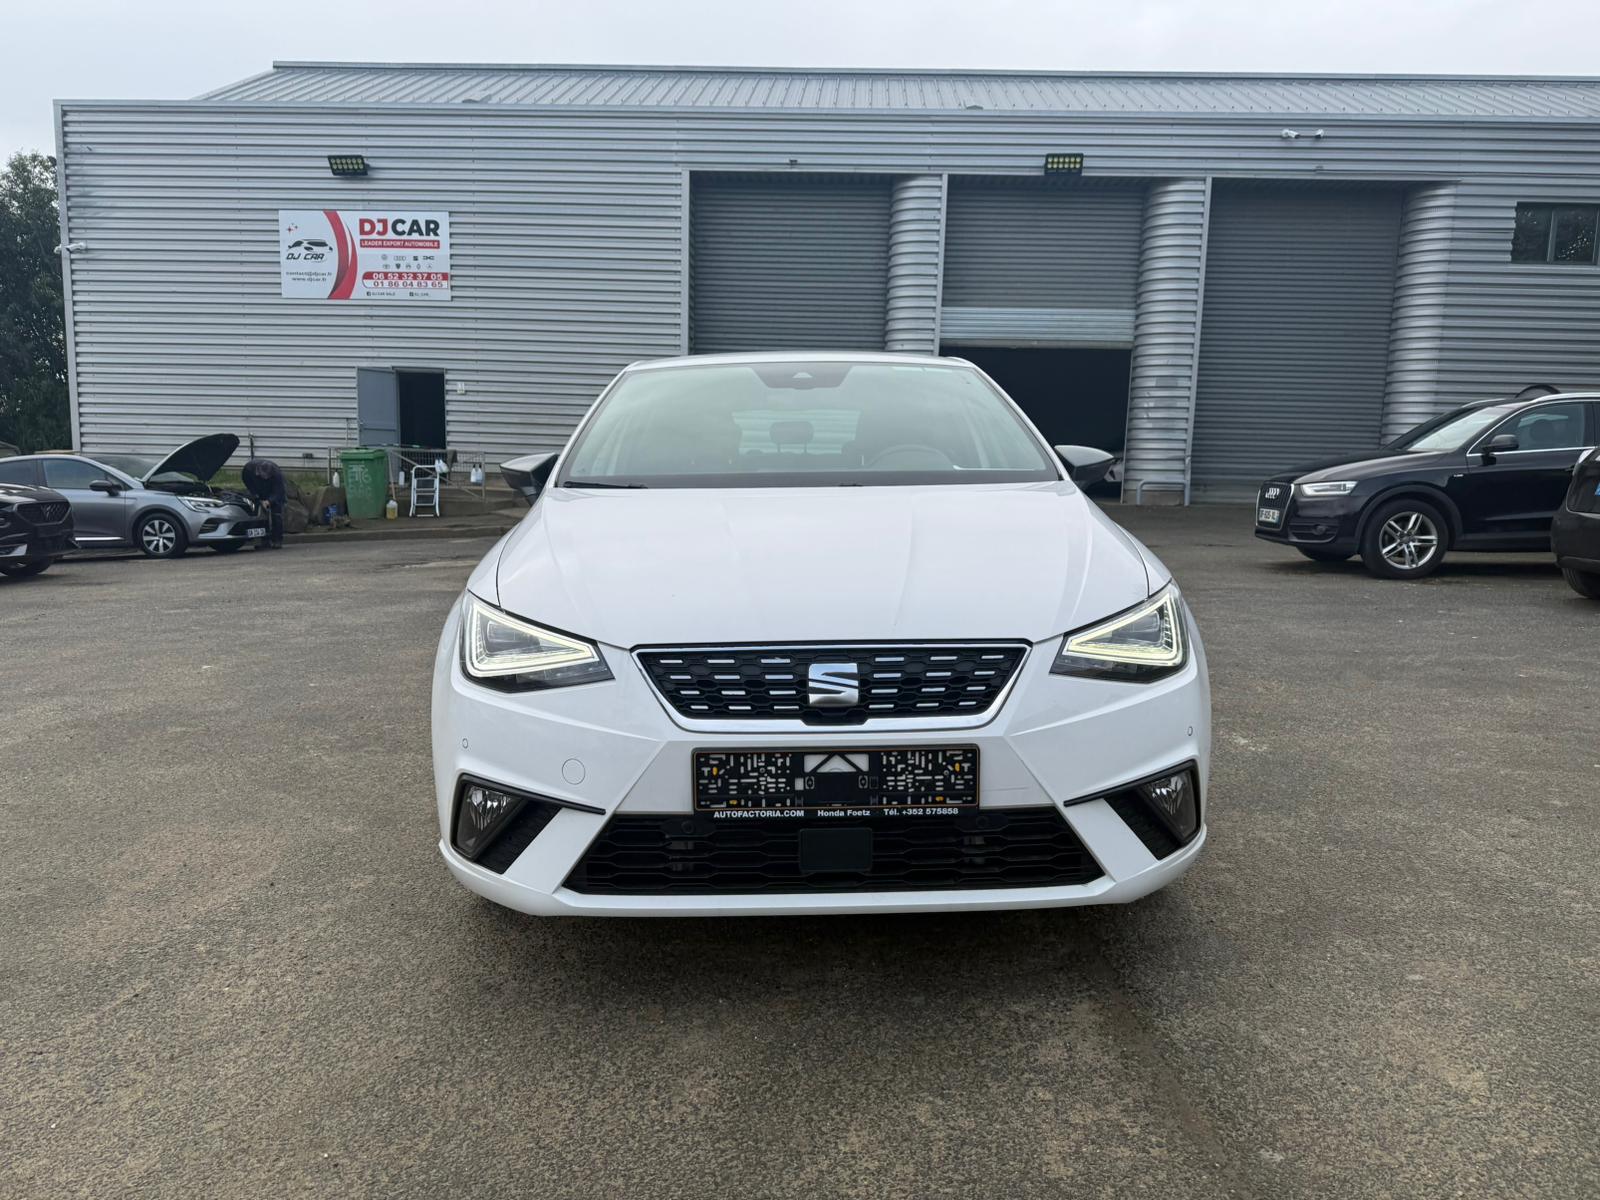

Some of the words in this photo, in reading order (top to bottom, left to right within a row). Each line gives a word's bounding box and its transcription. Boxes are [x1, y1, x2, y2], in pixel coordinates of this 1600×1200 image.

[359, 218, 388, 236] DJ
[391, 218, 440, 237] CAR
[387, 272, 399, 280] 52
[401, 272, 414, 280] 32
[713, 810, 805, 818] AUTOFACTORIA.COM
[817, 809, 844, 817] Honda
[847, 809, 871, 817] Foetz
